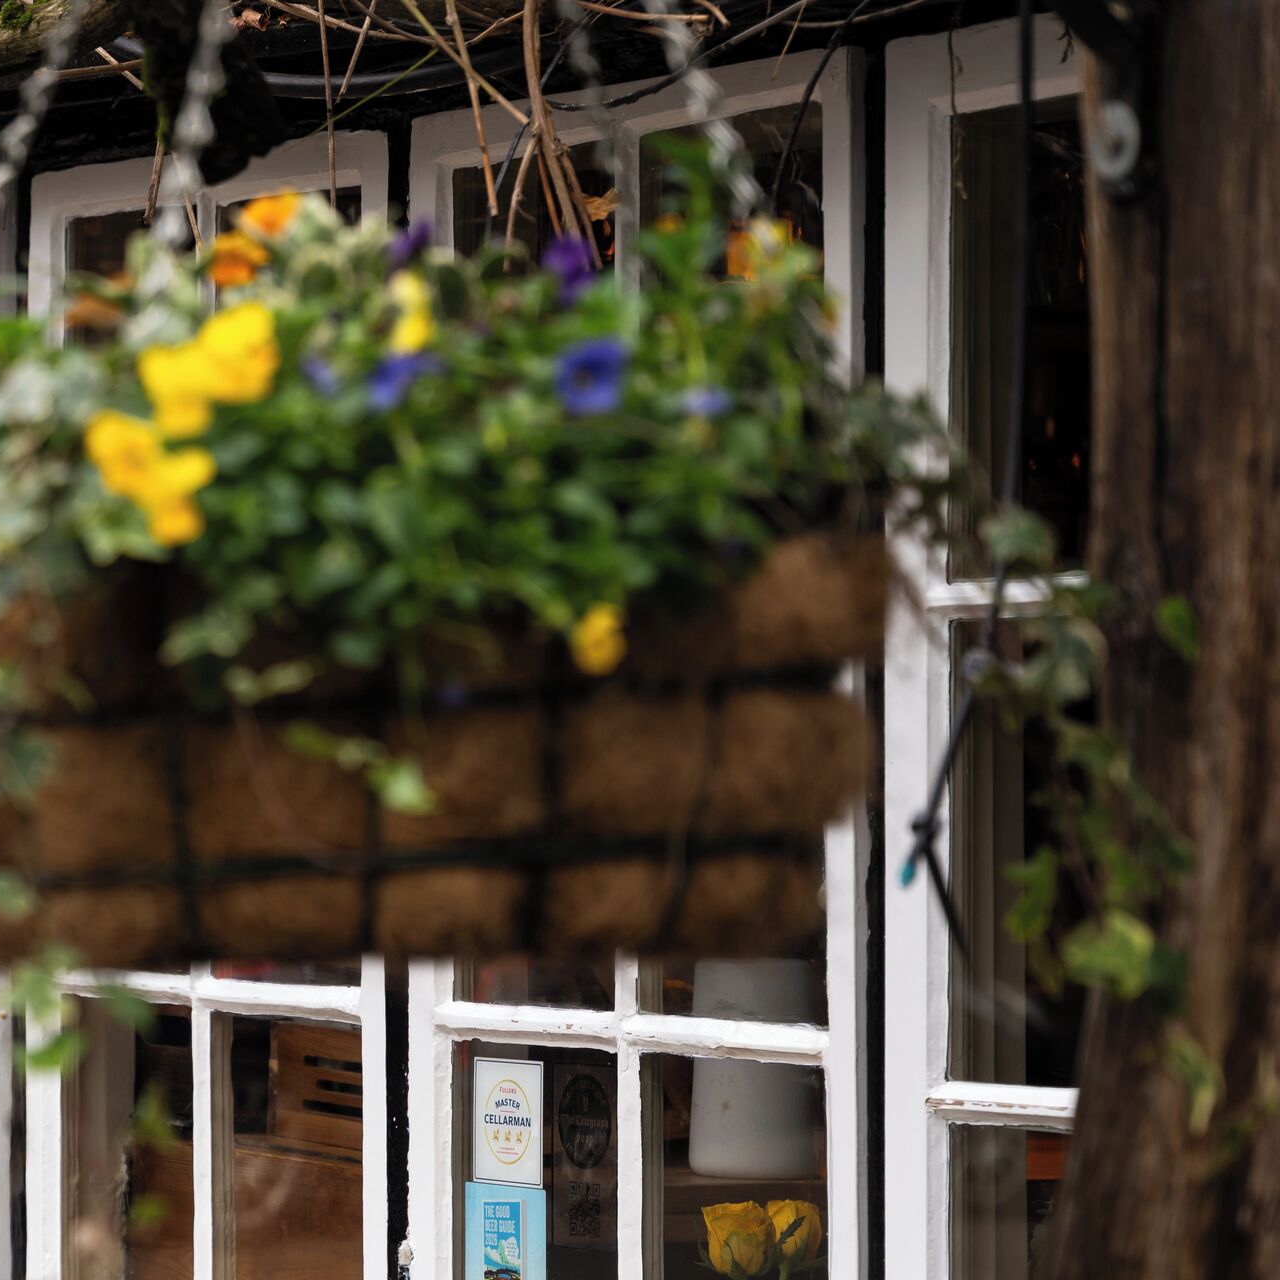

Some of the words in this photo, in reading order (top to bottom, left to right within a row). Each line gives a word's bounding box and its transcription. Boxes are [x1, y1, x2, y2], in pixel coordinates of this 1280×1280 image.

[495, 1098, 520, 1111] MASTER
[484, 1114, 531, 1127] CELLARMAN
[485, 1205, 494, 1217] THE
[495, 1205, 510, 1218] GOOD
[485, 1220, 497, 1232] BEER
[498, 1220, 515, 1233] GUIDE
[485, 1233, 497, 1245] 2026
